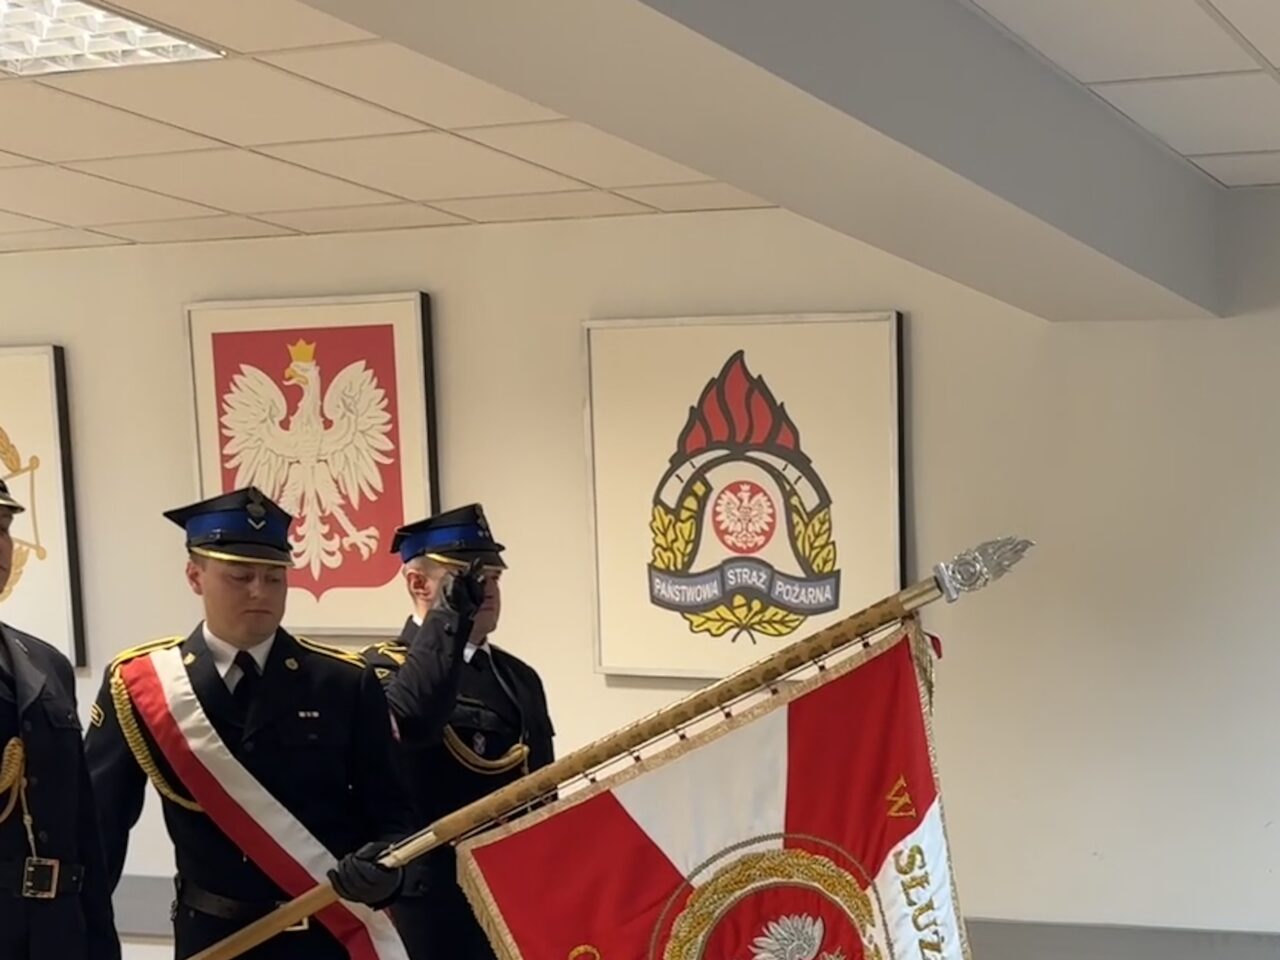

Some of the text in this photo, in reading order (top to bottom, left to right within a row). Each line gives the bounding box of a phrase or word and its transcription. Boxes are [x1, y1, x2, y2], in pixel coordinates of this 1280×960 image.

[654, 568, 833, 604] PAŃSTWOWA STRAŻ POŻARNA
[886, 774, 916, 818] W
